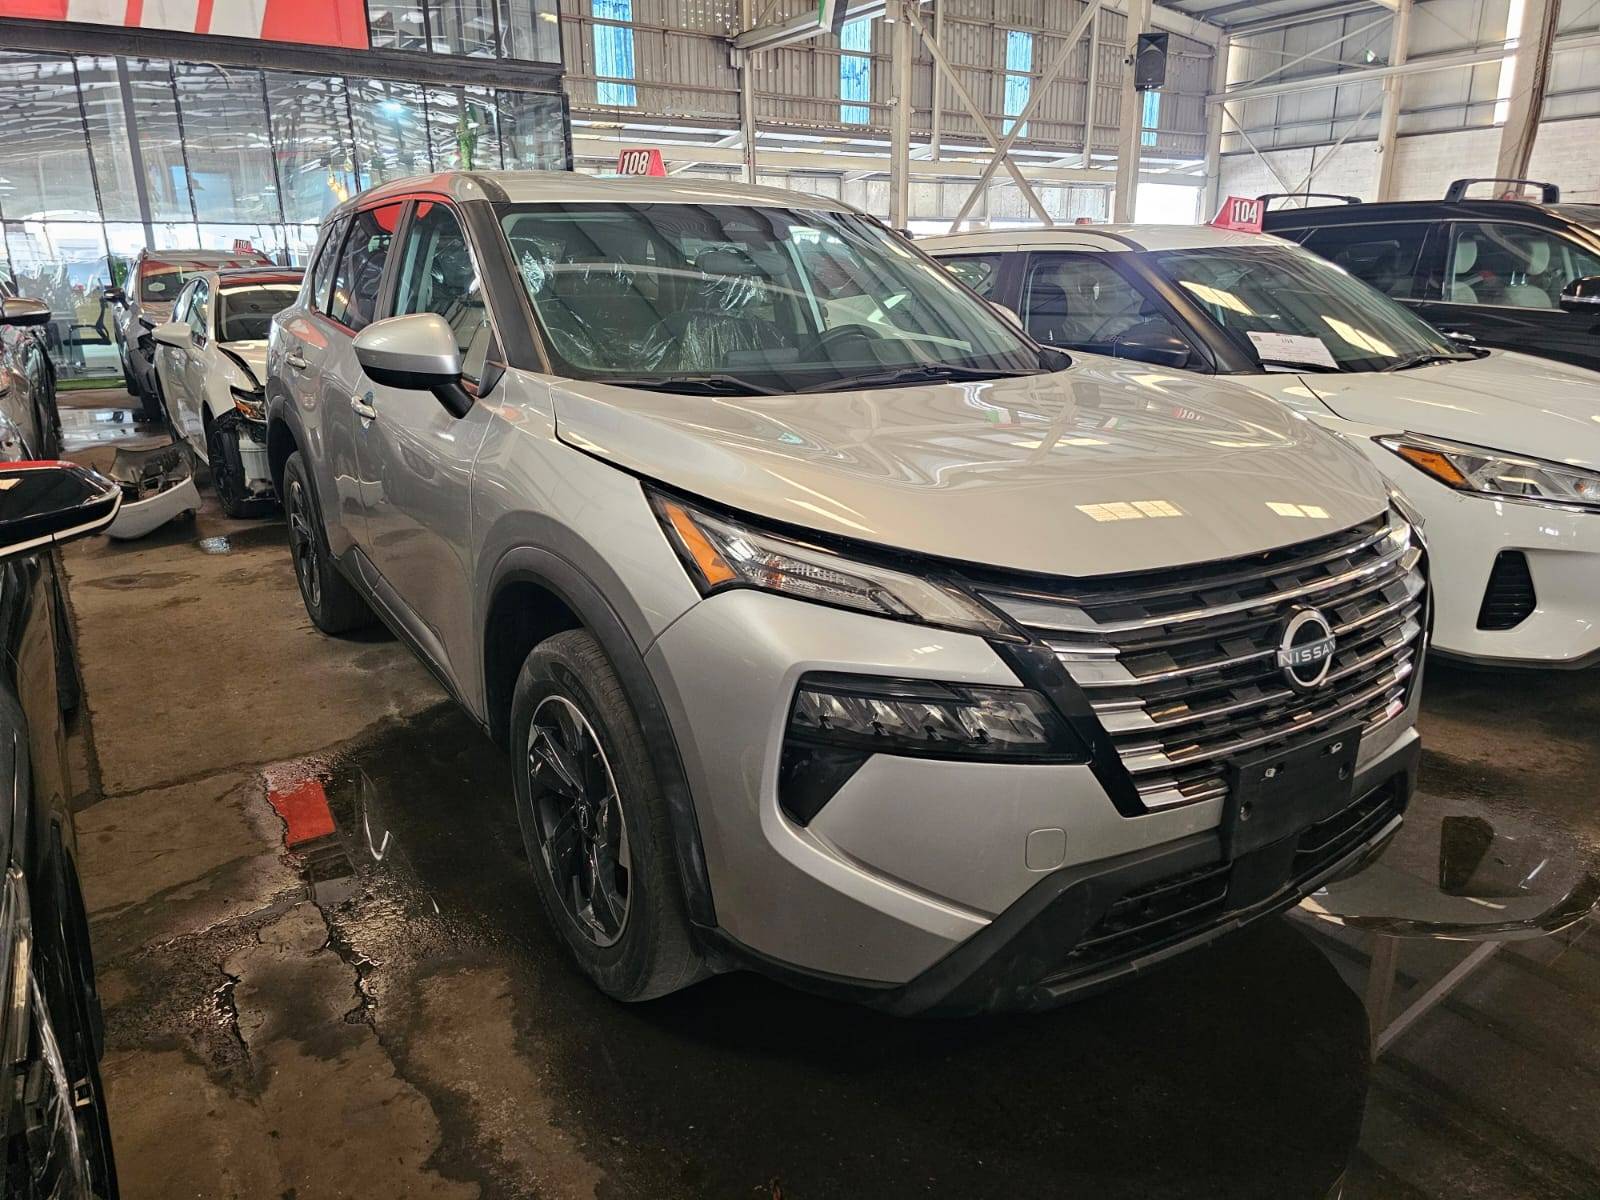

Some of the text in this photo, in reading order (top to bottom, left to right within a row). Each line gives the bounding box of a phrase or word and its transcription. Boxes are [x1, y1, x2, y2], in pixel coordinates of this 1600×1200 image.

[622, 152, 649, 175] 108
[1234, 201, 1258, 224] 104
[1279, 640, 1336, 666] NISSAN
